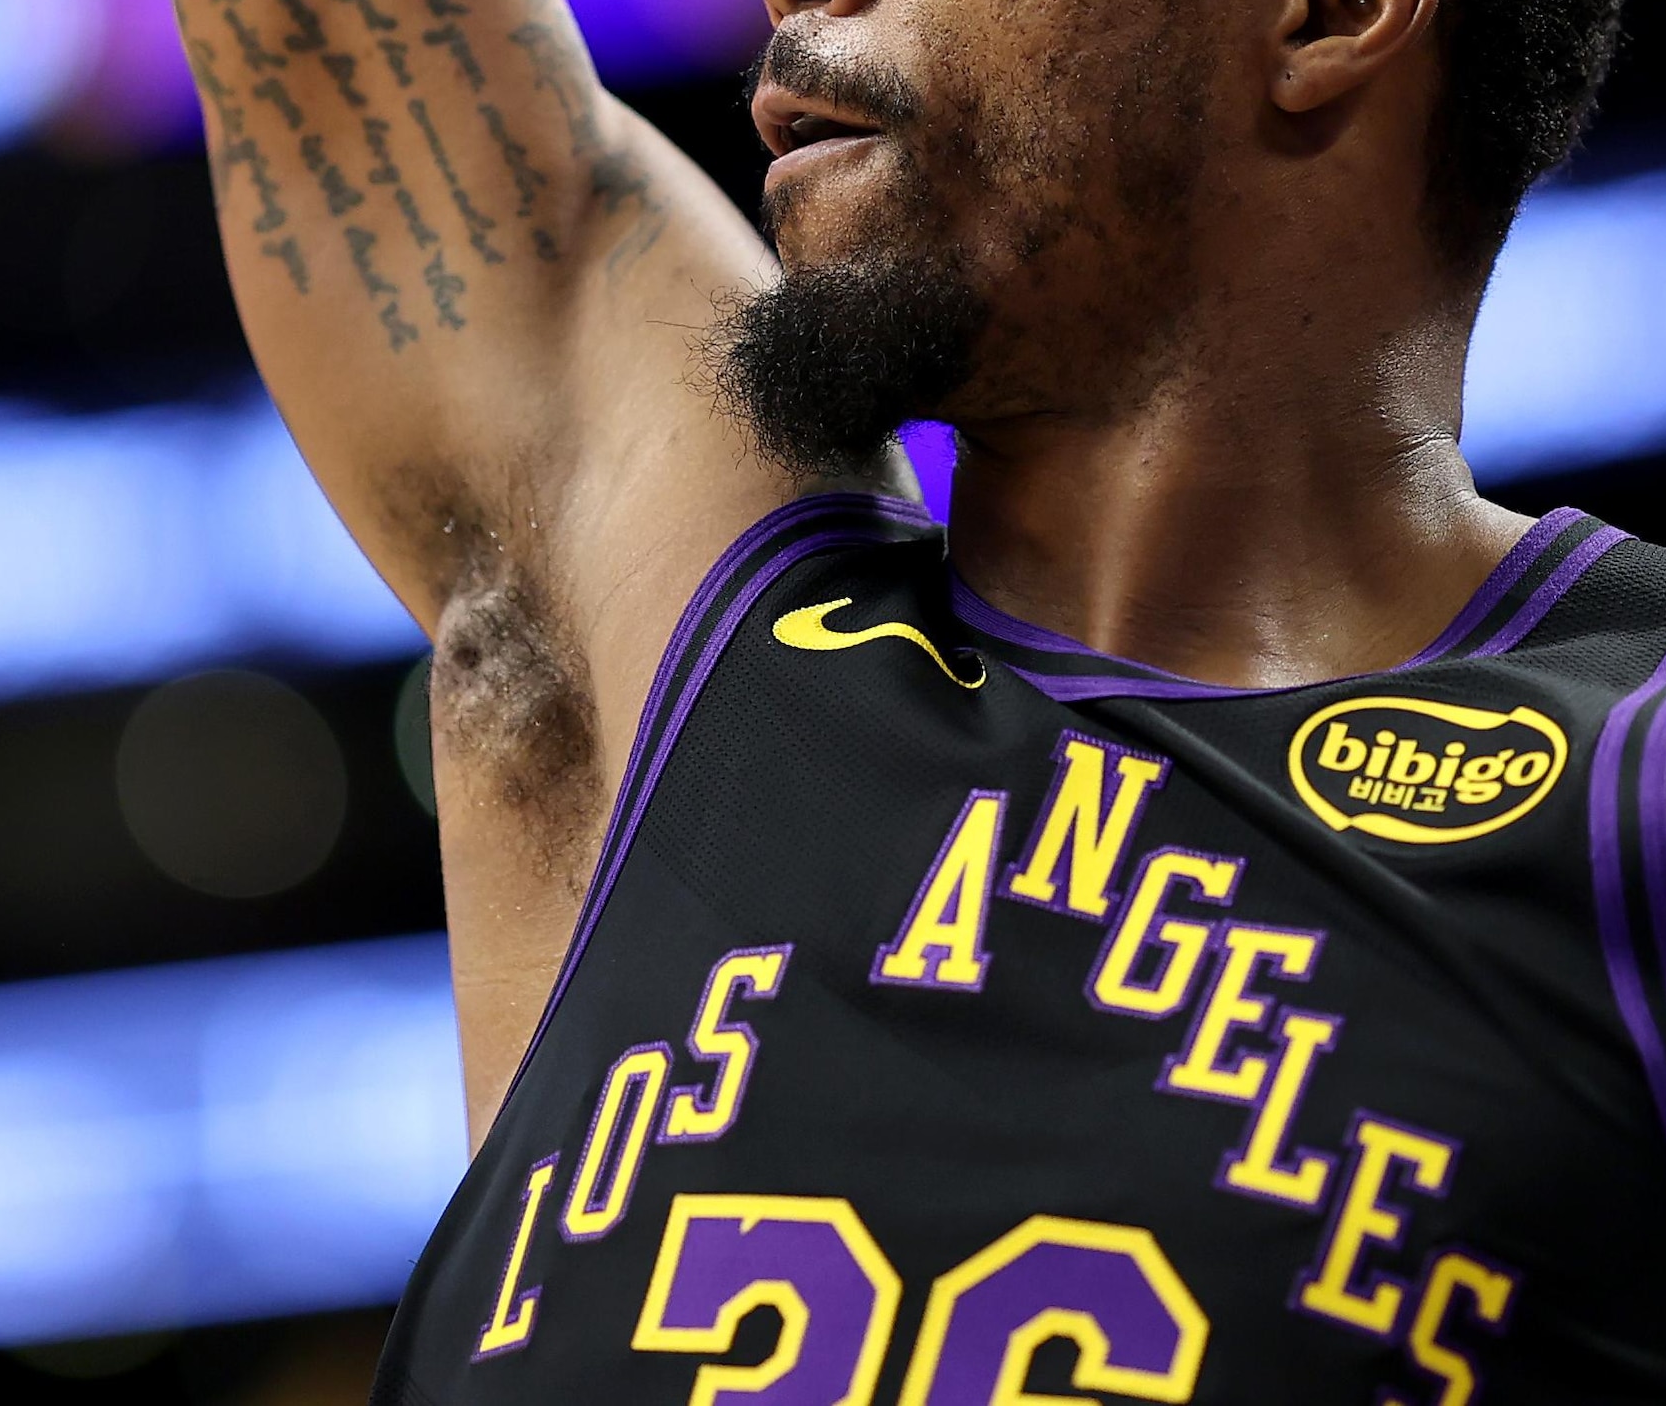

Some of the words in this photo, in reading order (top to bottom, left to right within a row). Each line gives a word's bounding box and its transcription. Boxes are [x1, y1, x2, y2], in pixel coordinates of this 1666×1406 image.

[1317, 721, 1551, 804] bibigo
[1347, 774, 1448, 813] 비비고
[470, 944, 793, 1364] LOS
[870, 729, 1521, 1406] ANGELES
